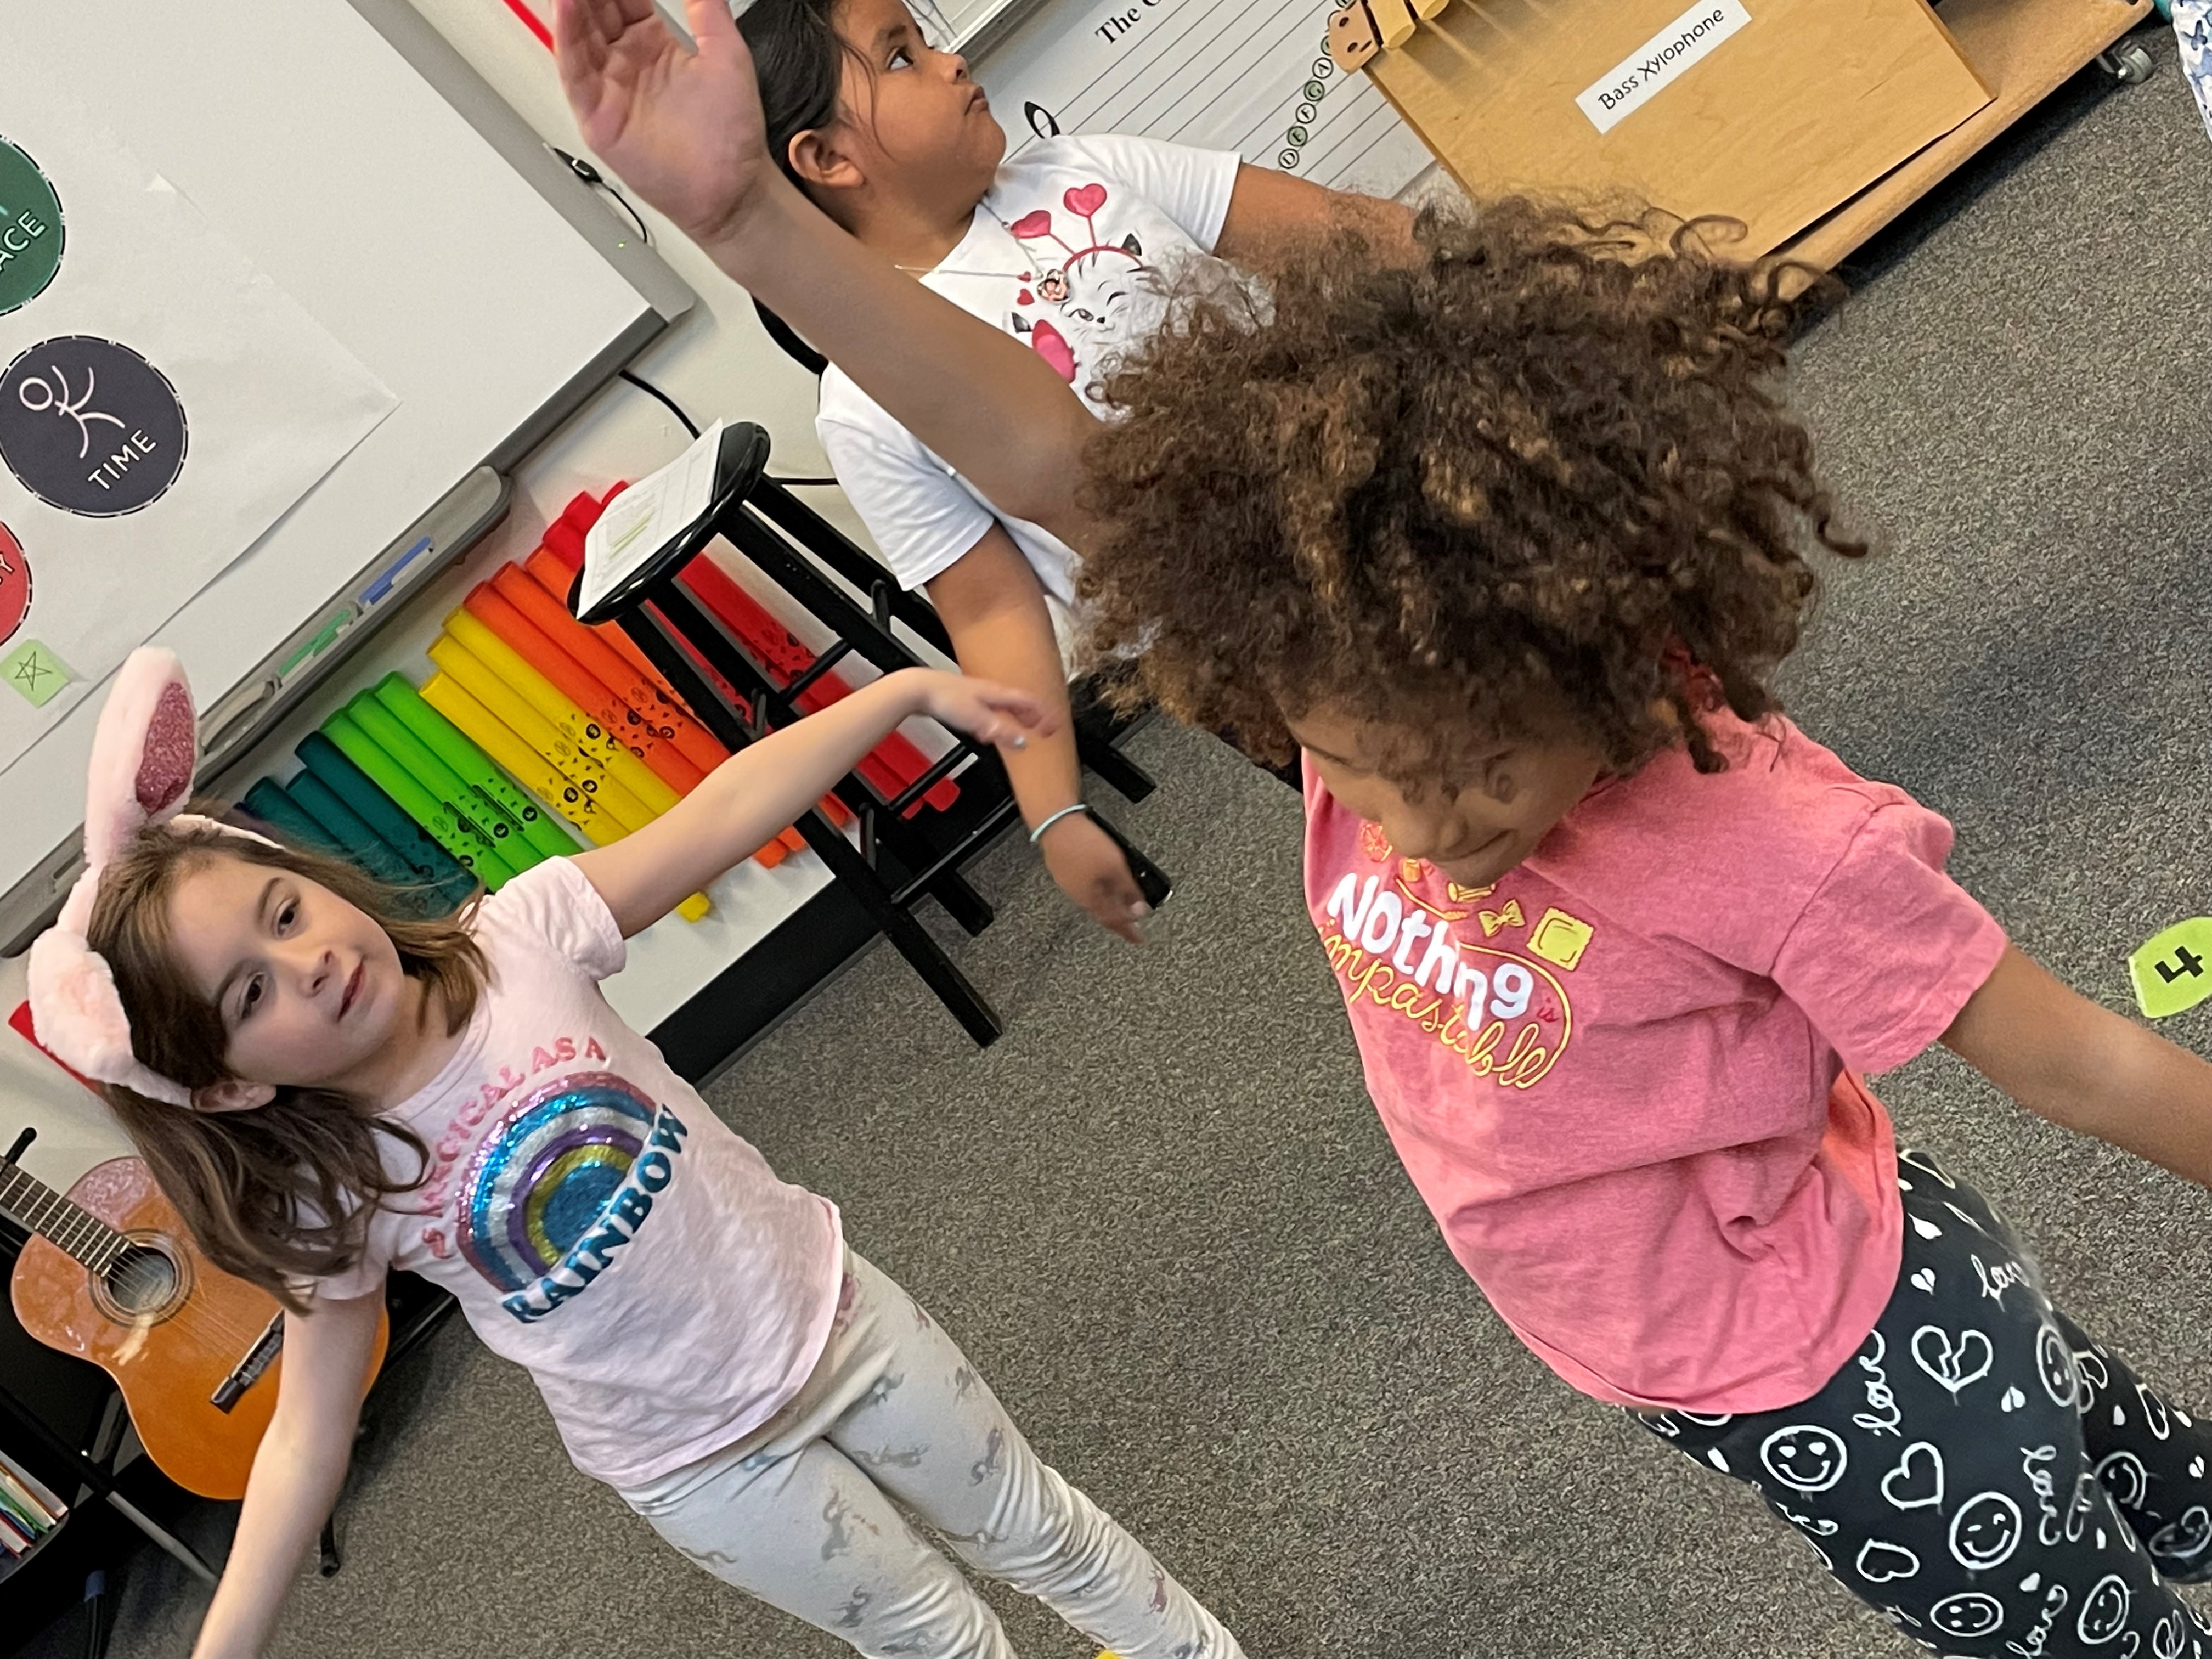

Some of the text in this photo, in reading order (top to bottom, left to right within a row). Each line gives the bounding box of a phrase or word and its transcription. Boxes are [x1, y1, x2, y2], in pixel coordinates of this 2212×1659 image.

[1094, 8, 1141, 44] The
[1598, 9, 1724, 110] Bass Xylophone
[87, 429, 157, 489] TIME
[1327, 873, 1534, 1031] Nothng
[2154, 945, 2204, 984] 4
[532, 1037, 577, 1074] AS
[585, 1036, 606, 1061] A
[501, 1103, 689, 1324] RAINBOW
